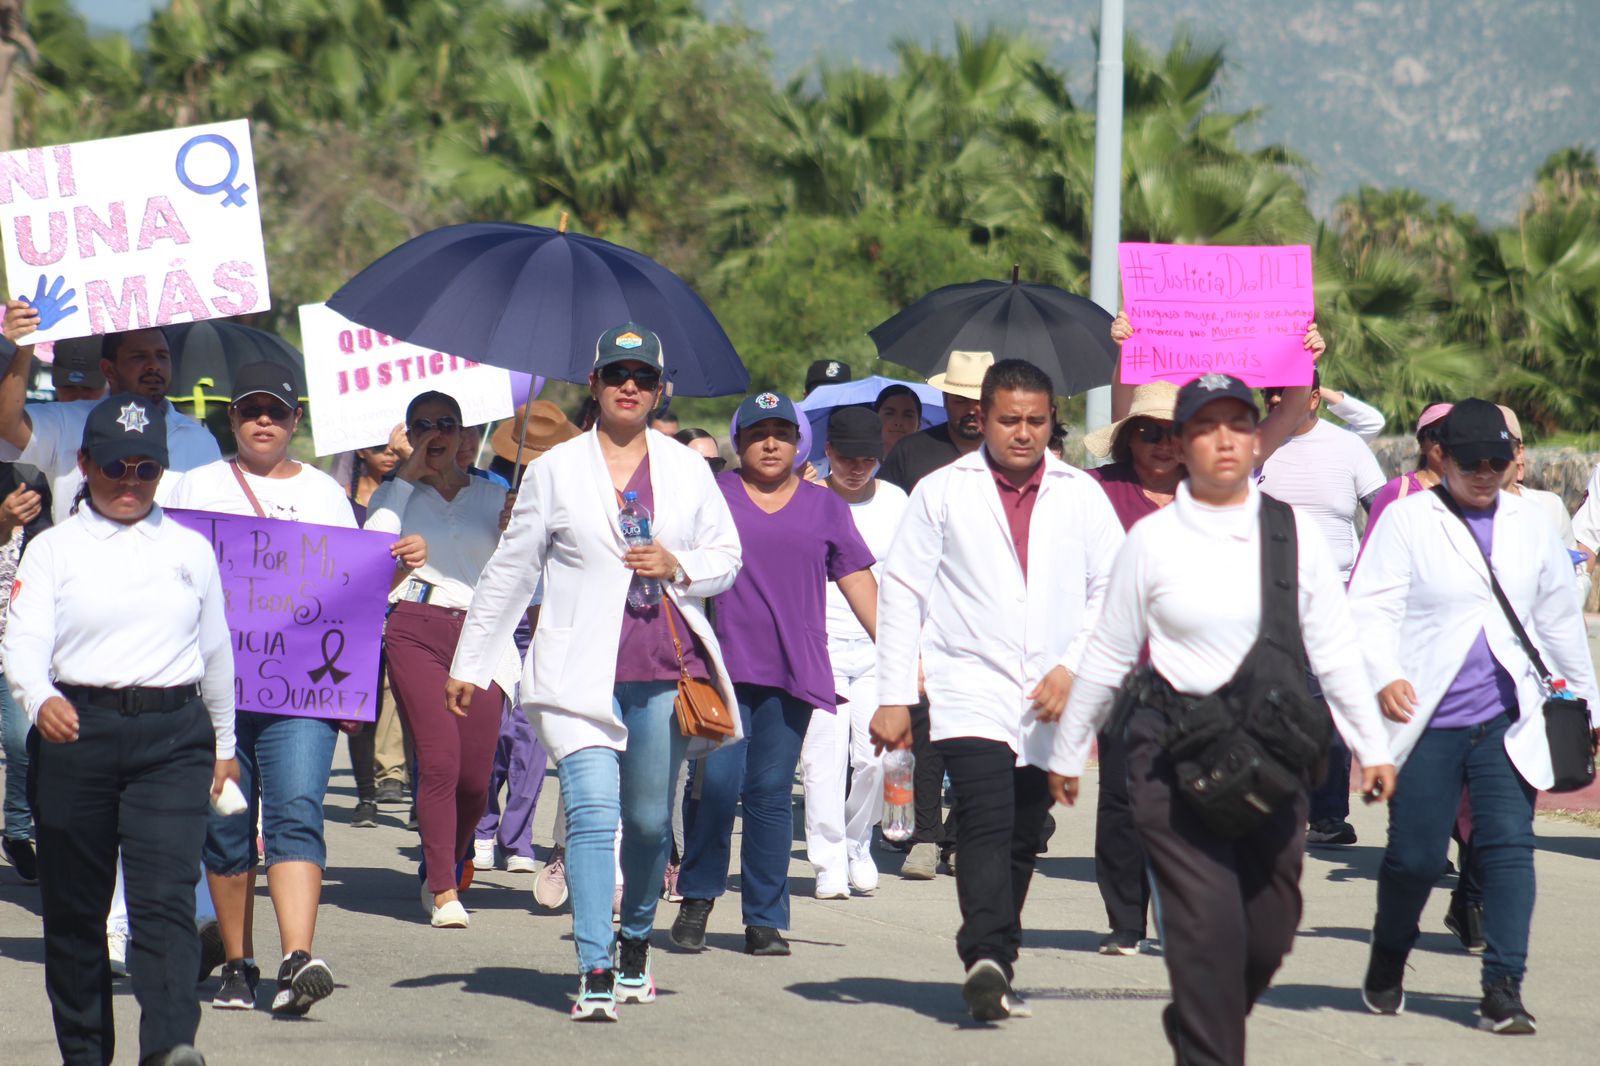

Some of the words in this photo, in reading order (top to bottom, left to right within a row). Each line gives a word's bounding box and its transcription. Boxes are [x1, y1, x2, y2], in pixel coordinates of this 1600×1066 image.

[0, 144, 77, 205] NI
[14, 195, 192, 267] UNA
[85, 258, 259, 335] MÁS
